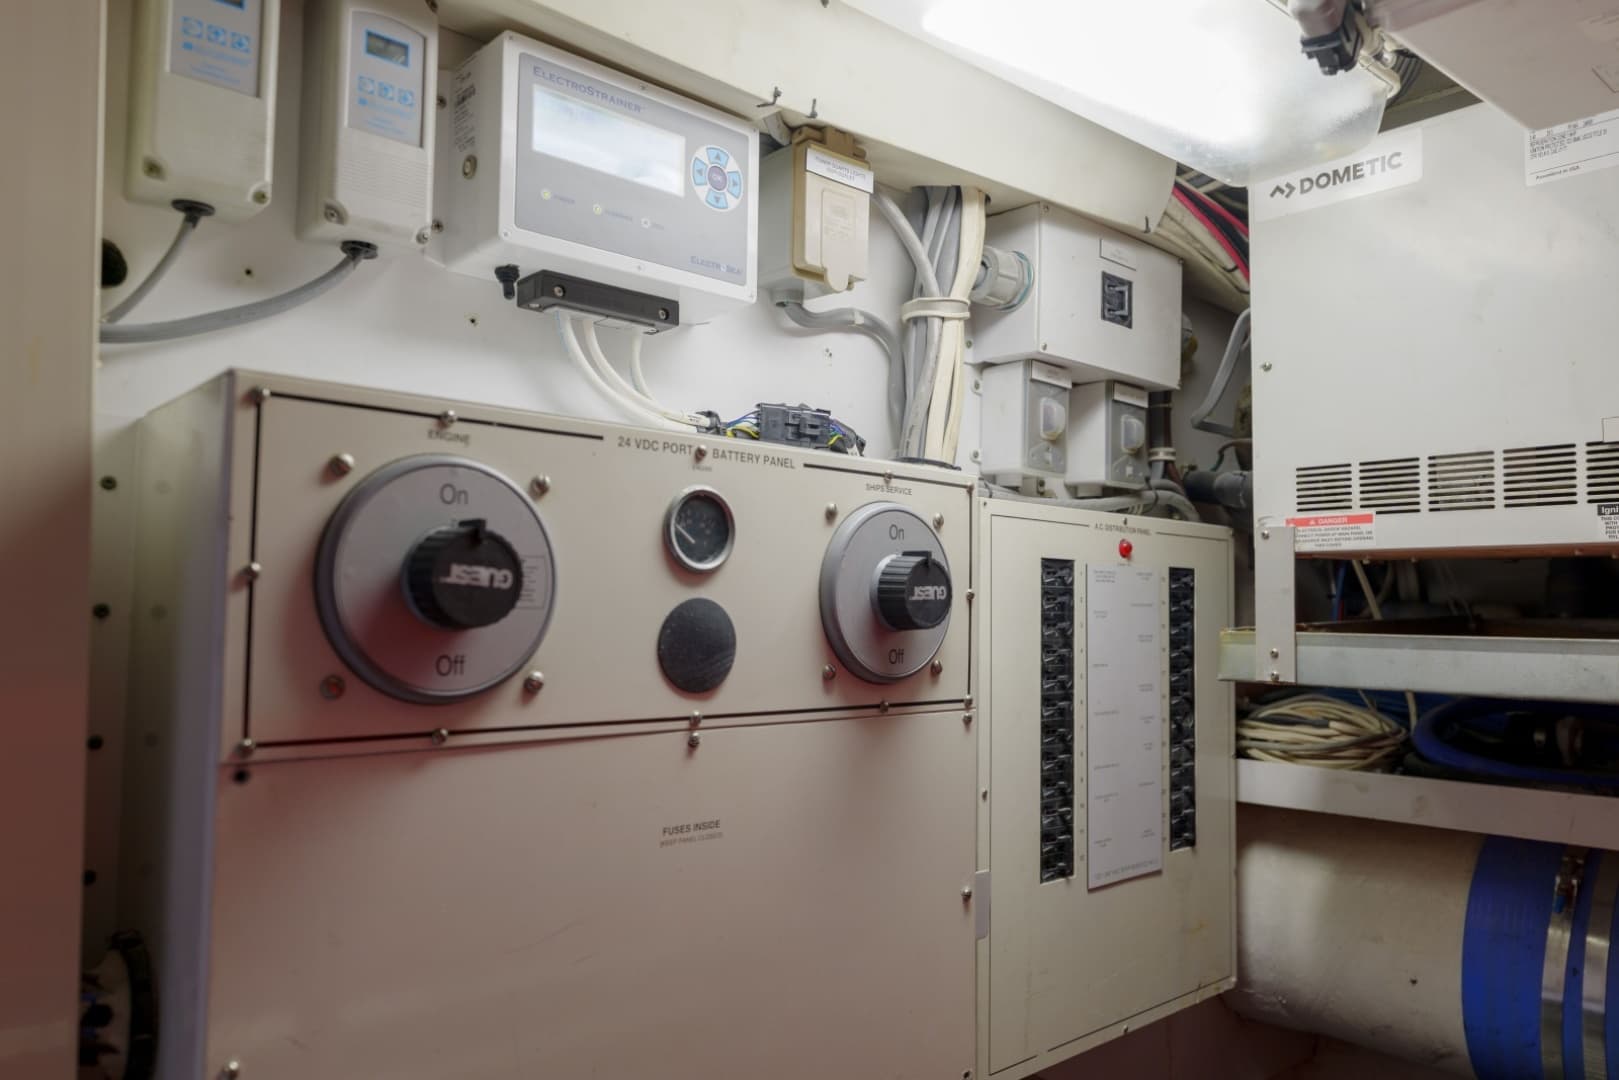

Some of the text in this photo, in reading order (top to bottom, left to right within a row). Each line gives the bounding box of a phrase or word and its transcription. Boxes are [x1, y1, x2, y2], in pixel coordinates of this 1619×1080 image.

[1299, 151, 1403, 195] DOMETIC
[427, 429, 470, 447] ENGINE
[617, 435, 796, 470] 24 VDC PORT BATTERY PANEL
[439, 483, 469, 505] On
[886, 485, 913, 496] SERVICE
[1317, 516, 1348, 526] DANGER
[888, 523, 905, 541] On
[438, 563, 514, 590] GUEST
[908, 585, 947, 601] GUEST
[435, 653, 466, 677] Off
[888, 647, 905, 665] Off
[662, 819, 721, 837] FUSES INSIDE
